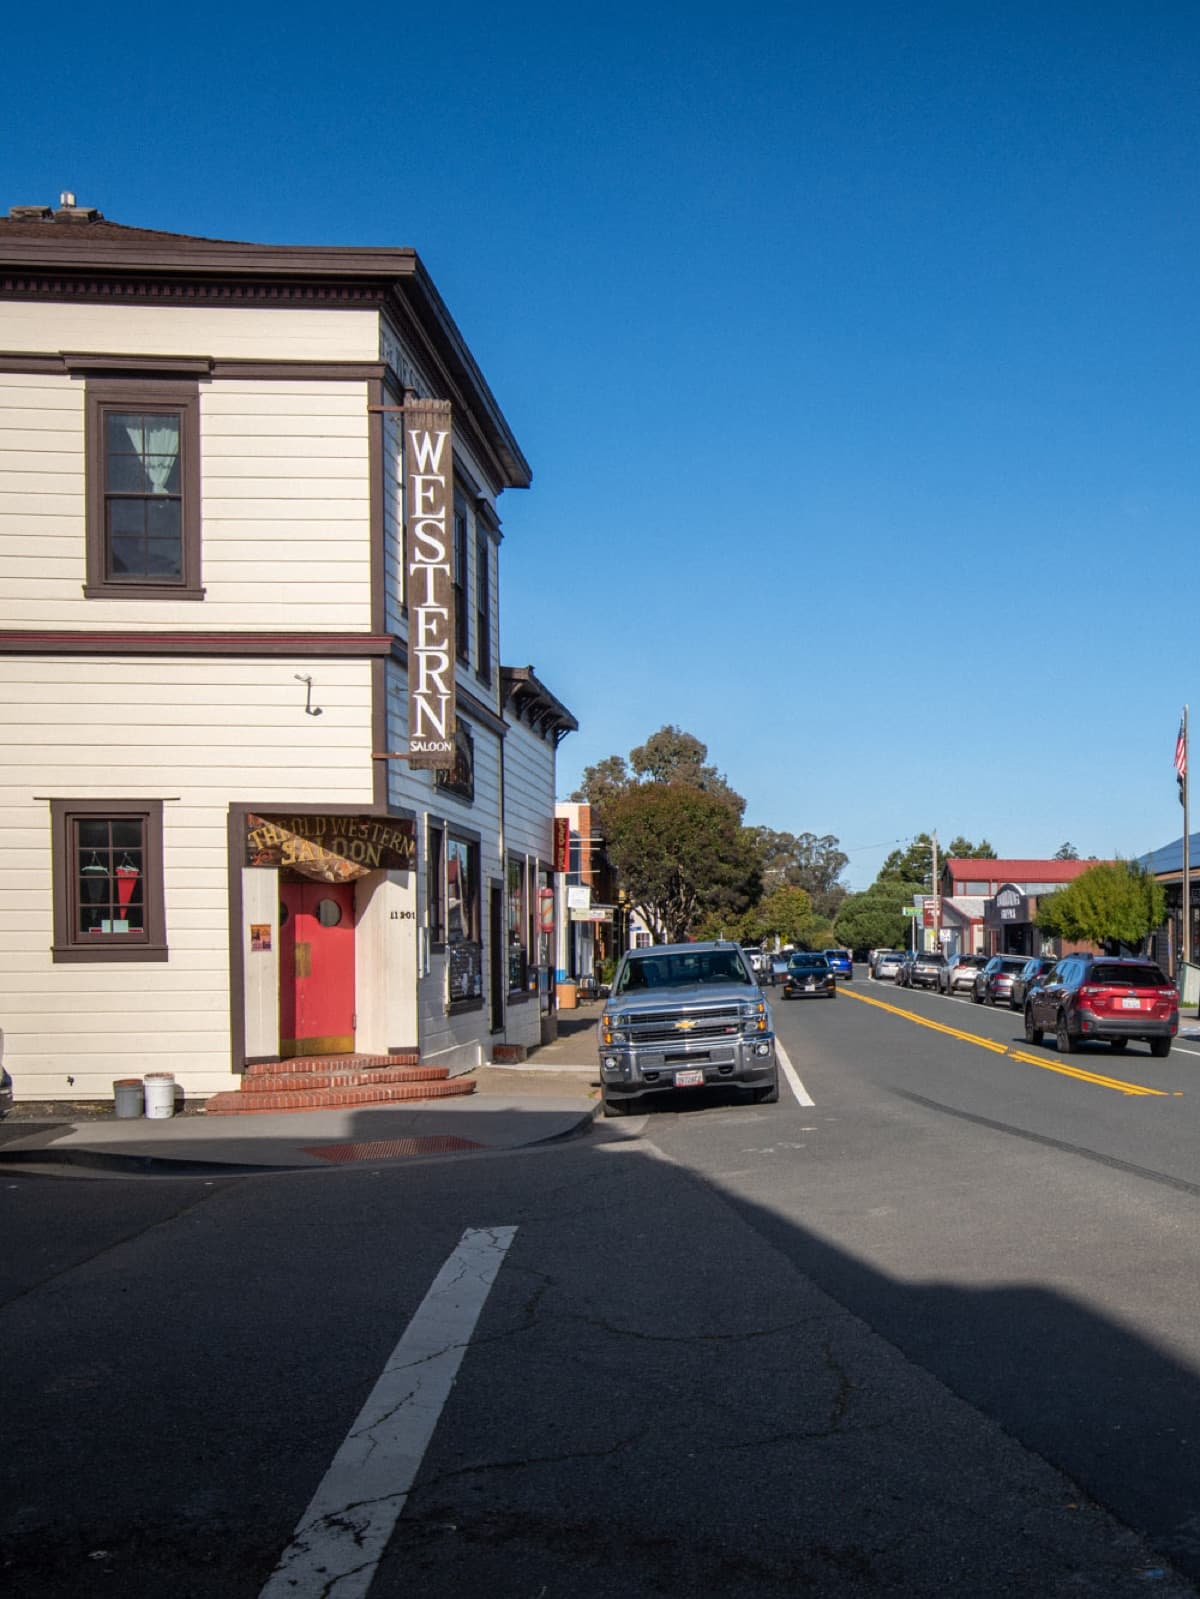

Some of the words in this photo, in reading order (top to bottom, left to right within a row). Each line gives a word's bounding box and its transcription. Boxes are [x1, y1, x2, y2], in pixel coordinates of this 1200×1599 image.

[408, 430, 451, 739] WESTERN
[410, 741, 452, 752] SALOON
[248, 819, 290, 850] THE
[291, 816, 326, 838] OLD
[331, 816, 416, 858] WESTERN
[281, 837, 383, 867] SALOON
